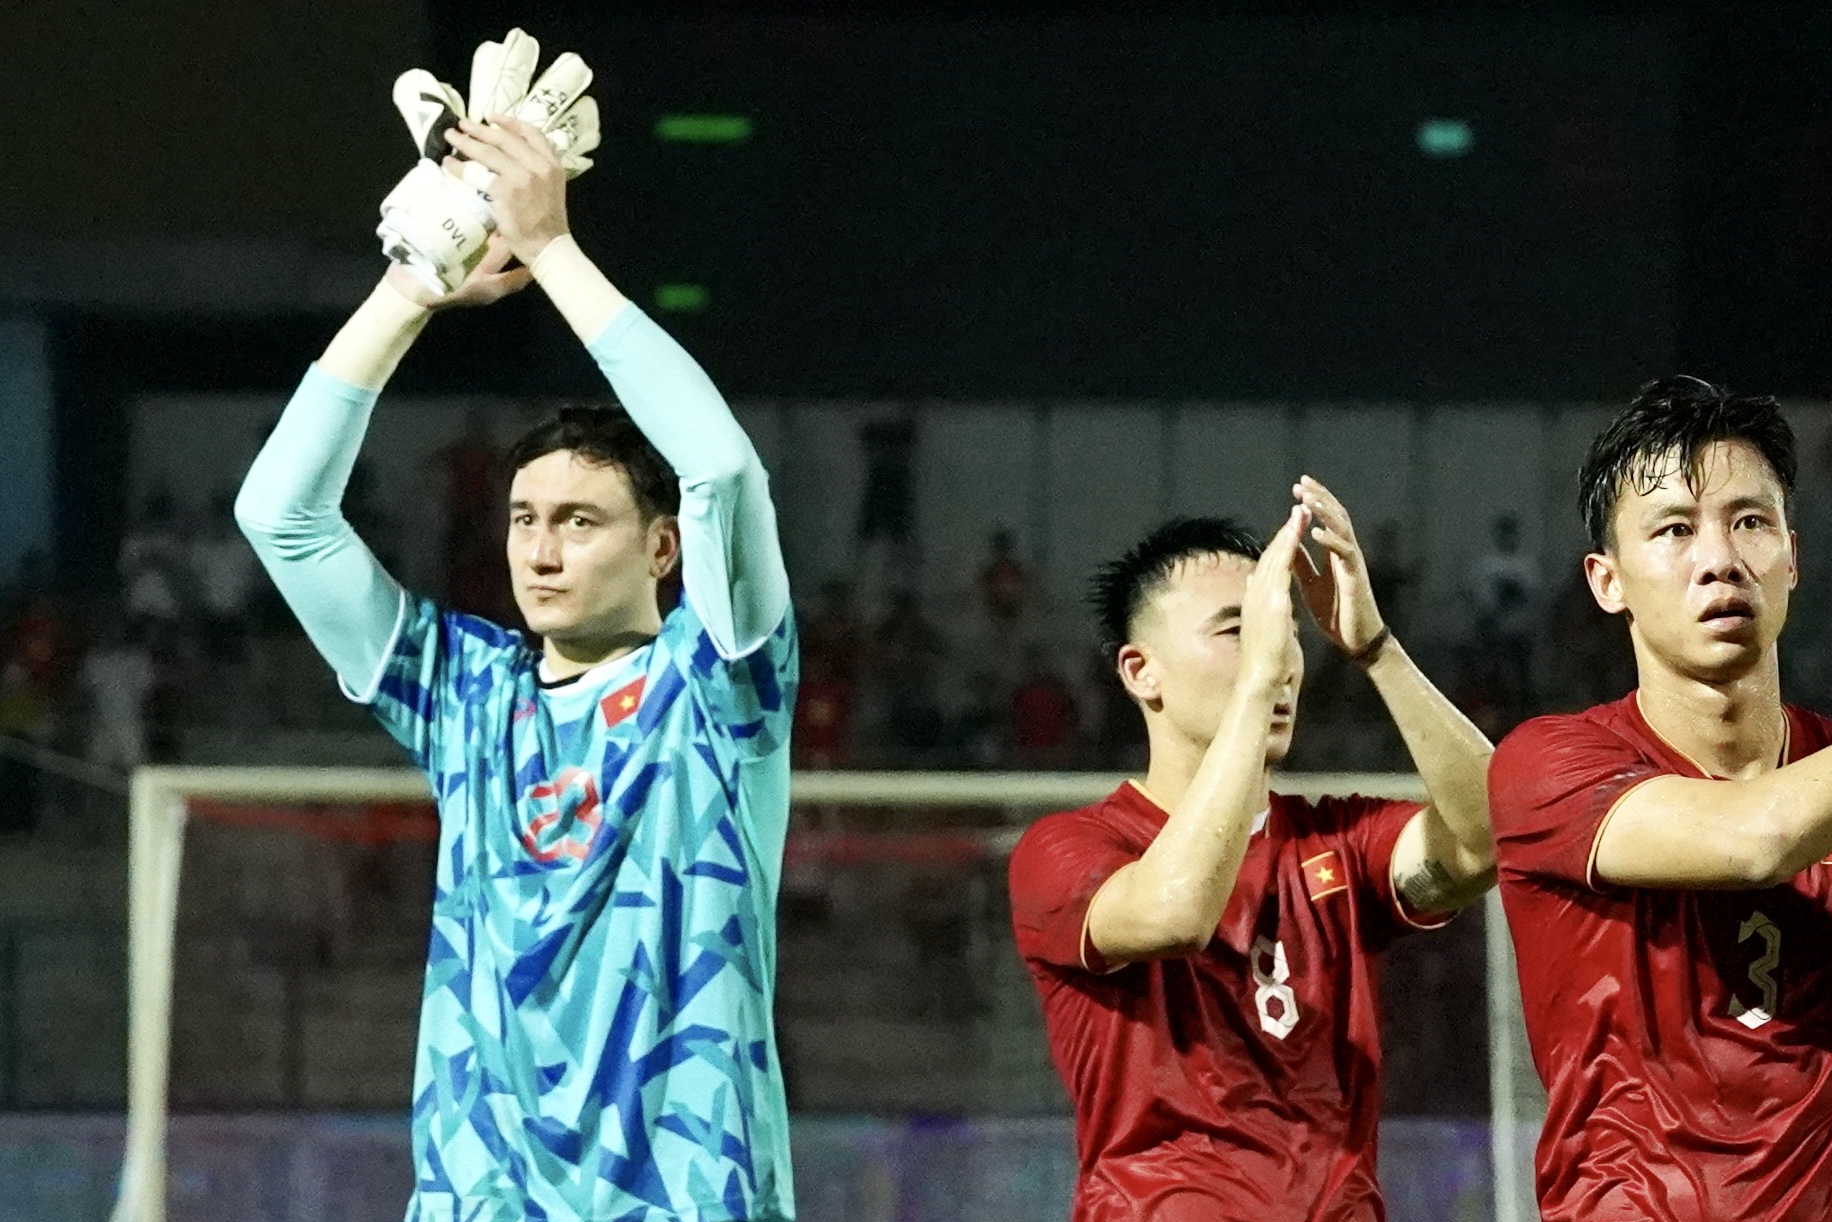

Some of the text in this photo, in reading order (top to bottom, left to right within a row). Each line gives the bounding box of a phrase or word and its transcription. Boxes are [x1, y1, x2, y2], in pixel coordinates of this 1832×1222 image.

[521, 767, 605, 865] 23
[1250, 934, 1300, 1040] 8
[1727, 909, 1781, 1030] 3
